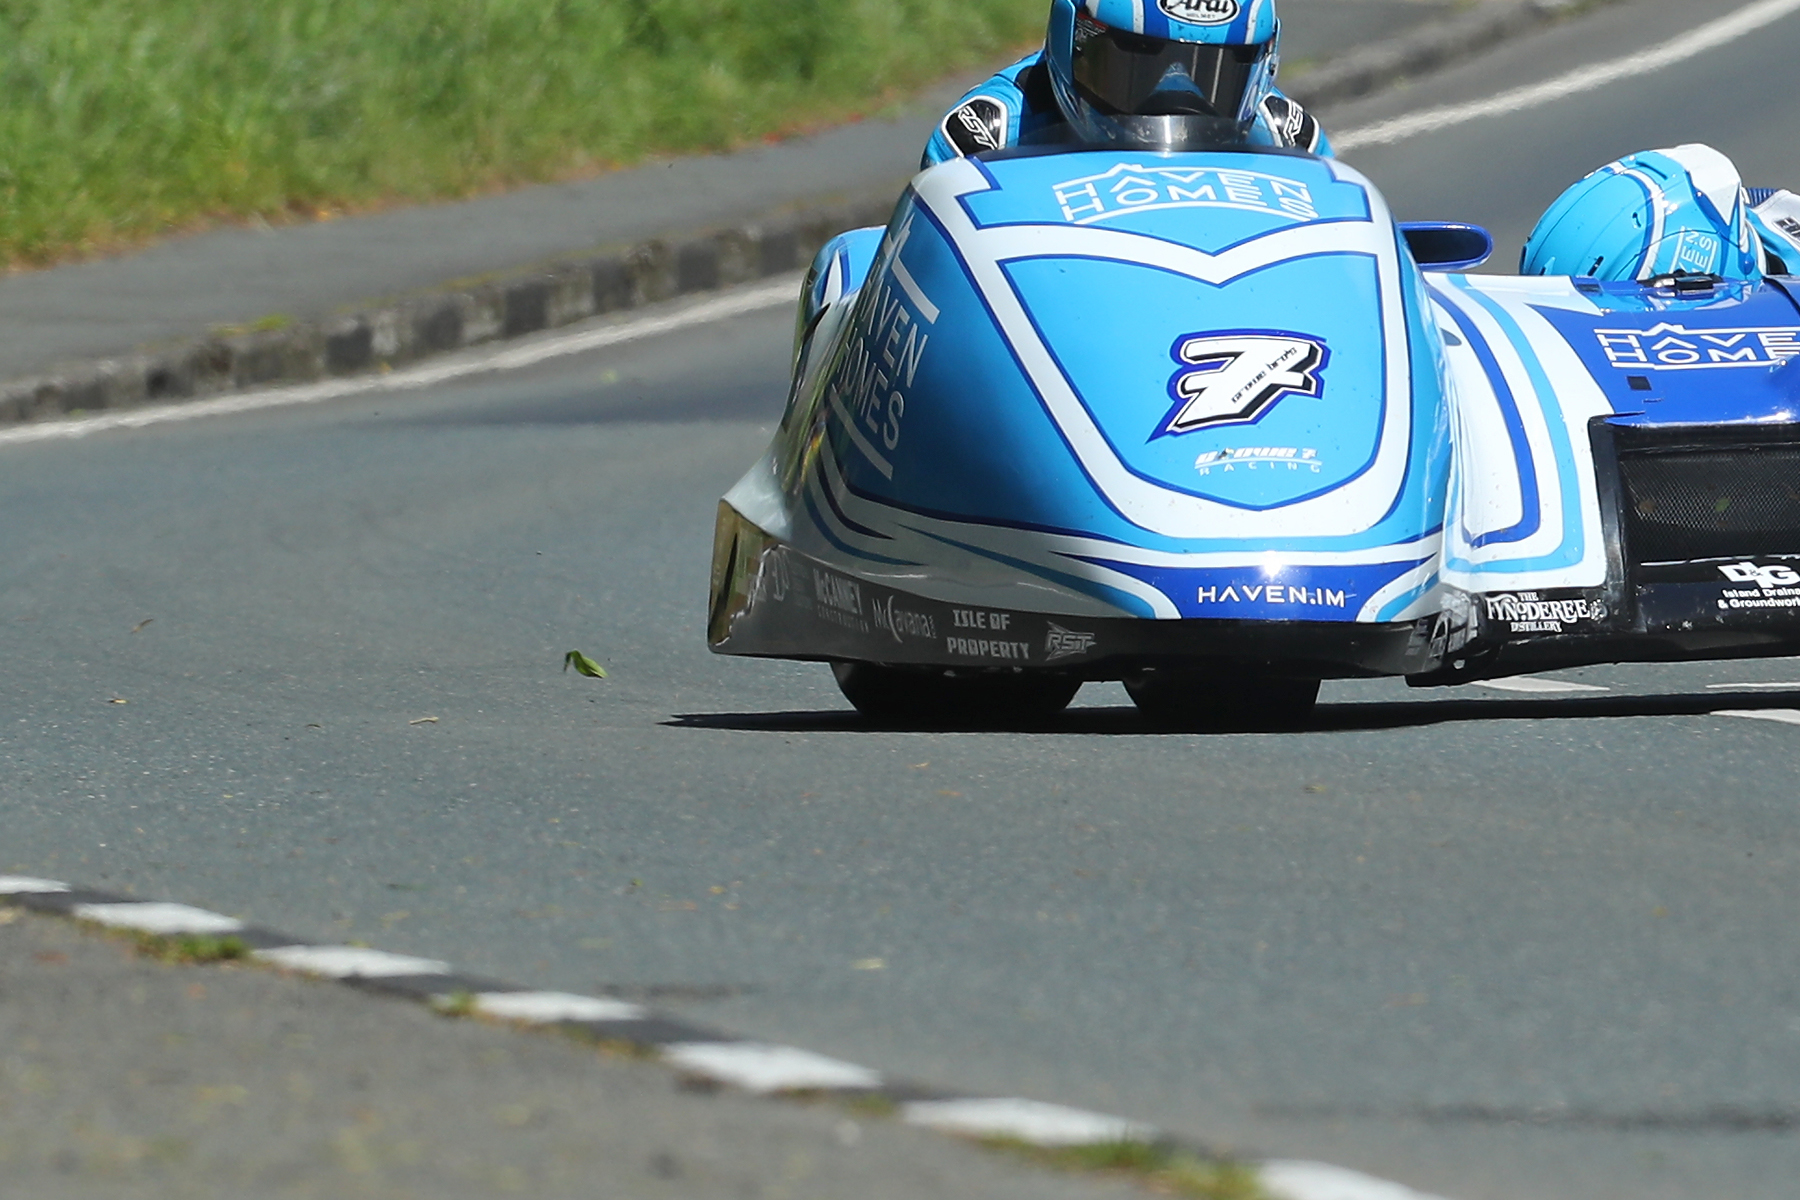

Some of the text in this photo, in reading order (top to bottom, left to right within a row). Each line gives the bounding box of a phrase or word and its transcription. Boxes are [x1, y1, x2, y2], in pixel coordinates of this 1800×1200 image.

[957, 106, 997, 150] RST
[1055, 171, 1312, 206] HAVEN
[1062, 184, 1320, 221] HOMES
[860, 257, 929, 388] HAVEN
[836, 320, 905, 450] HOMES
[1174, 334, 1323, 432] 7
[1199, 461, 1321, 476] RACING
[1198, 585, 1345, 607] HAVEN.IM
[1517, 591, 1539, 602] THE
[1717, 599, 1729, 609] &
[1723, 587, 1760, 598] Island
[953, 609, 986, 630] ISLE
[989, 611, 1011, 631] OF
[946, 636, 1030, 660] PROPERTY
